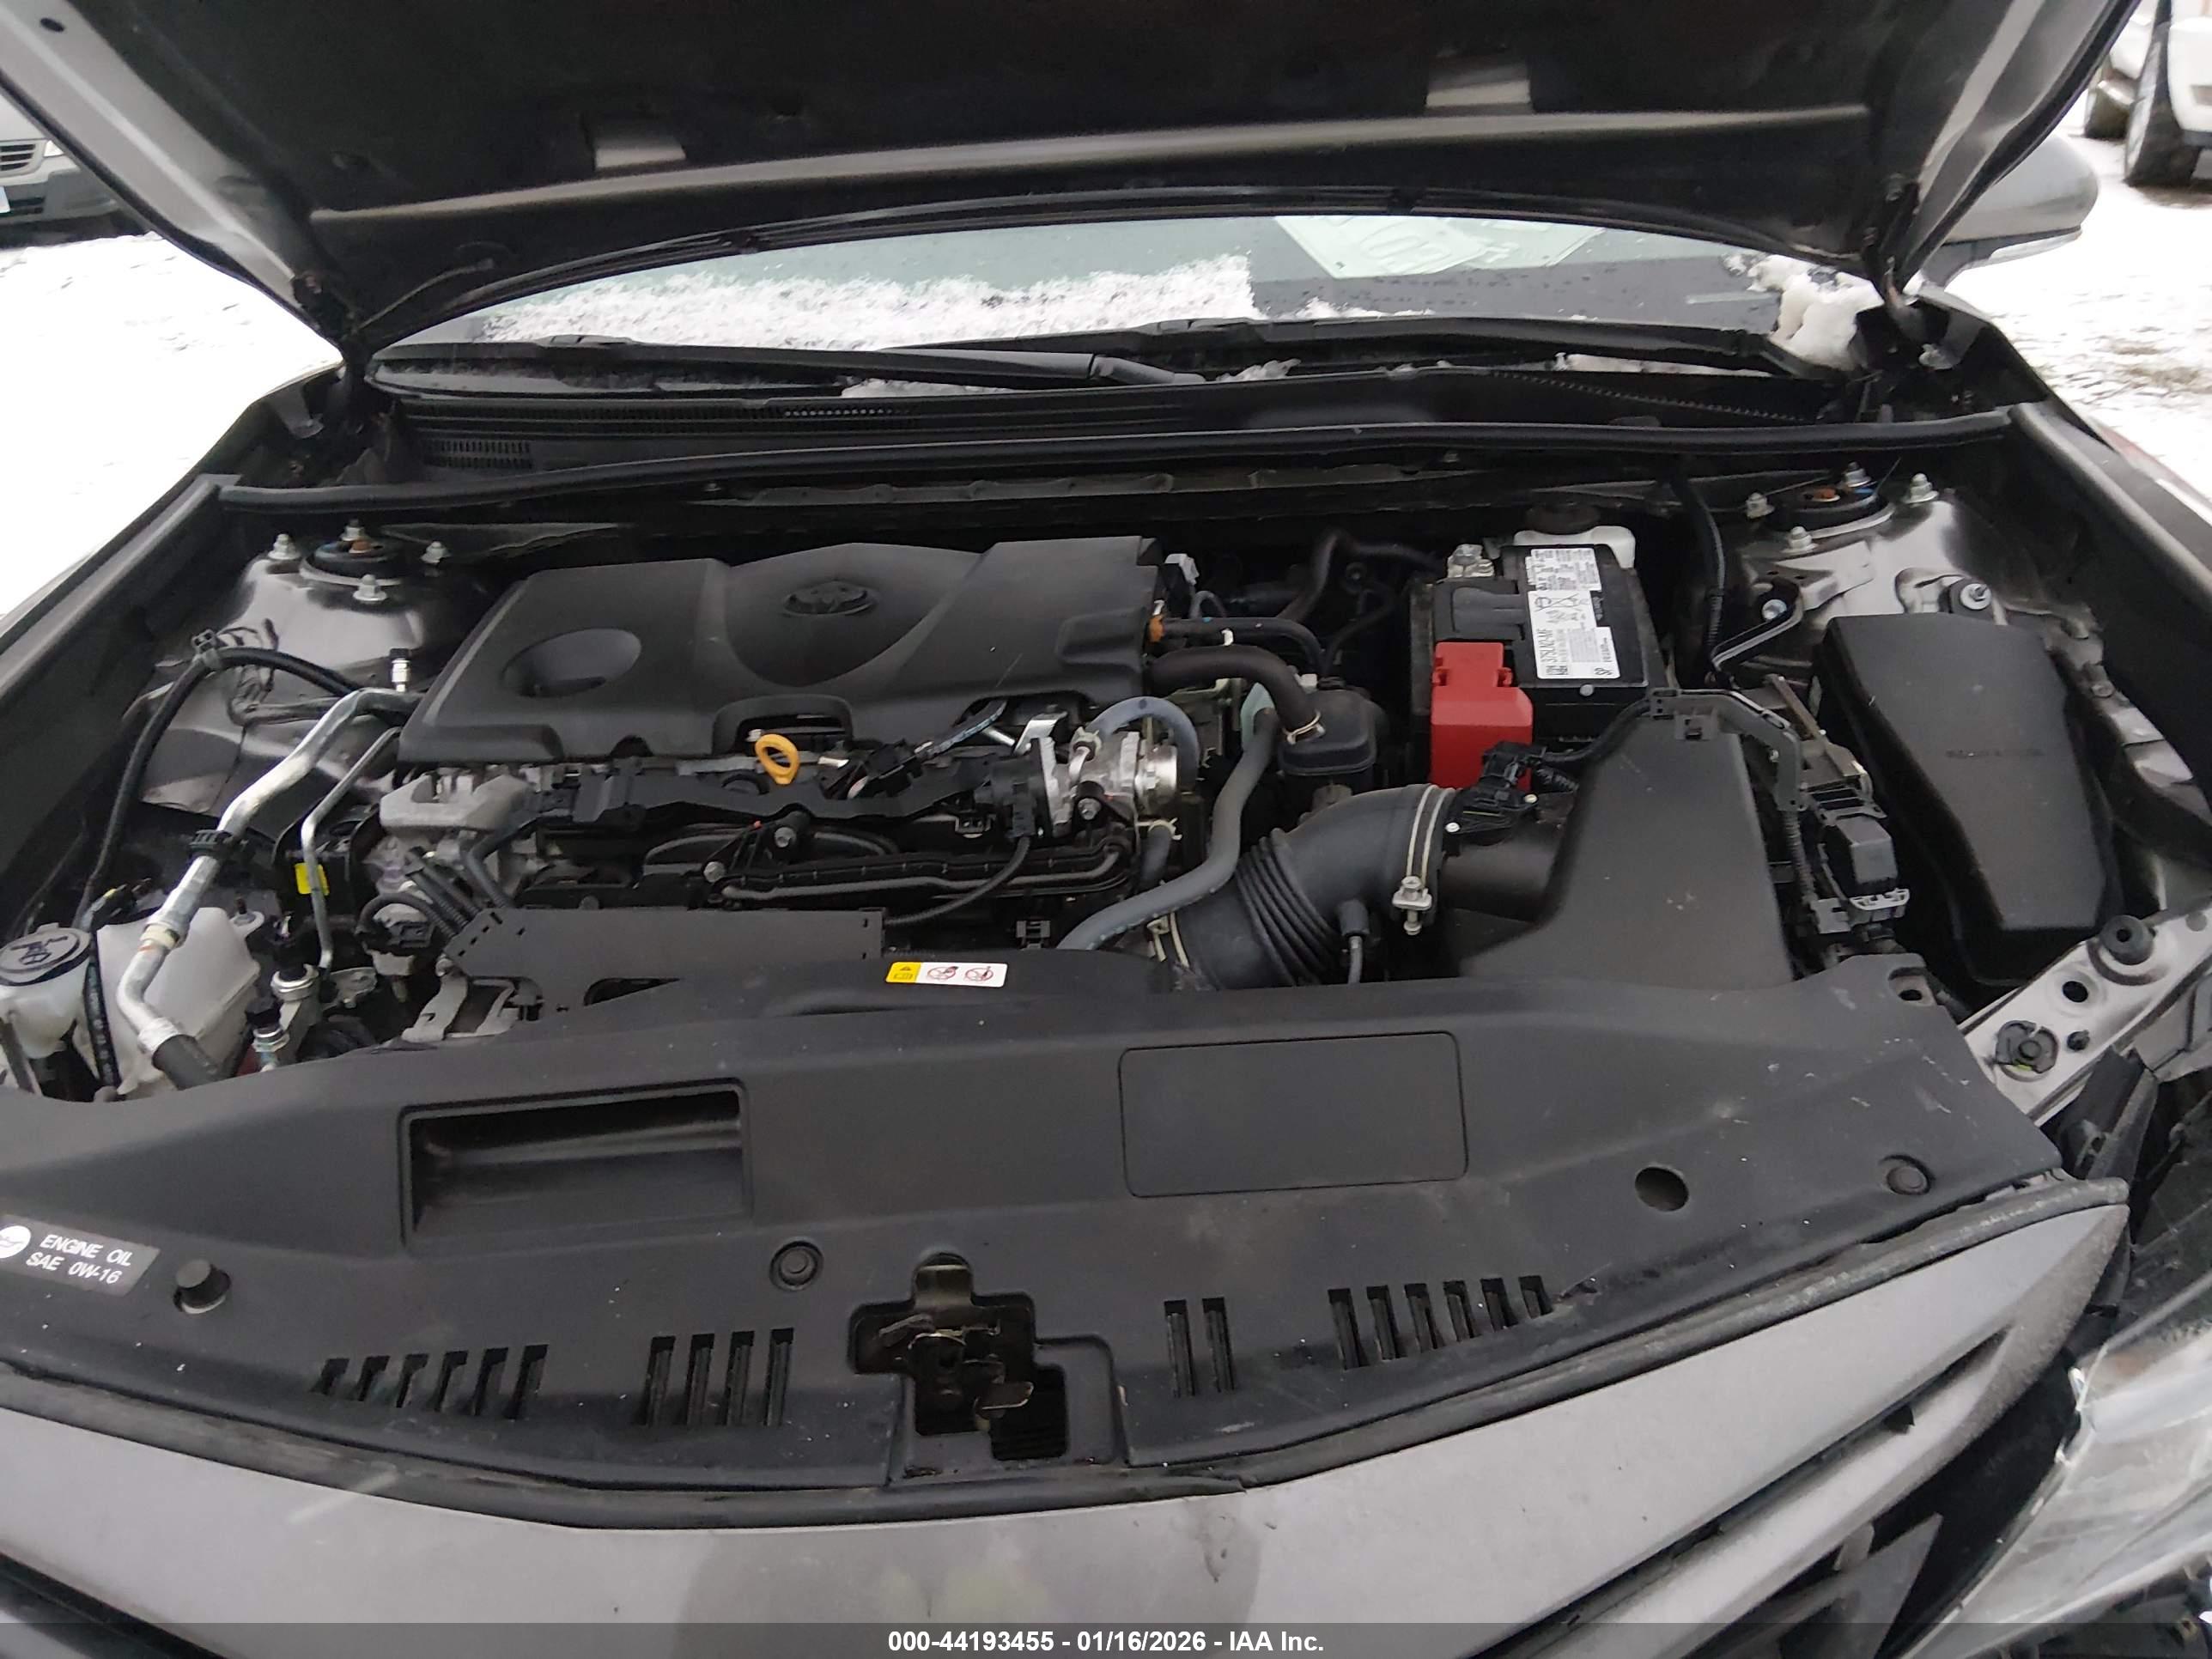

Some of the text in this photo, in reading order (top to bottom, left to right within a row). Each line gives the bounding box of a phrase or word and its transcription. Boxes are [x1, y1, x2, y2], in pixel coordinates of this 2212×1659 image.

[40, 1234, 133, 1267] ENGINE OIL
[26, 1252, 122, 1285] SAE 0W-16
